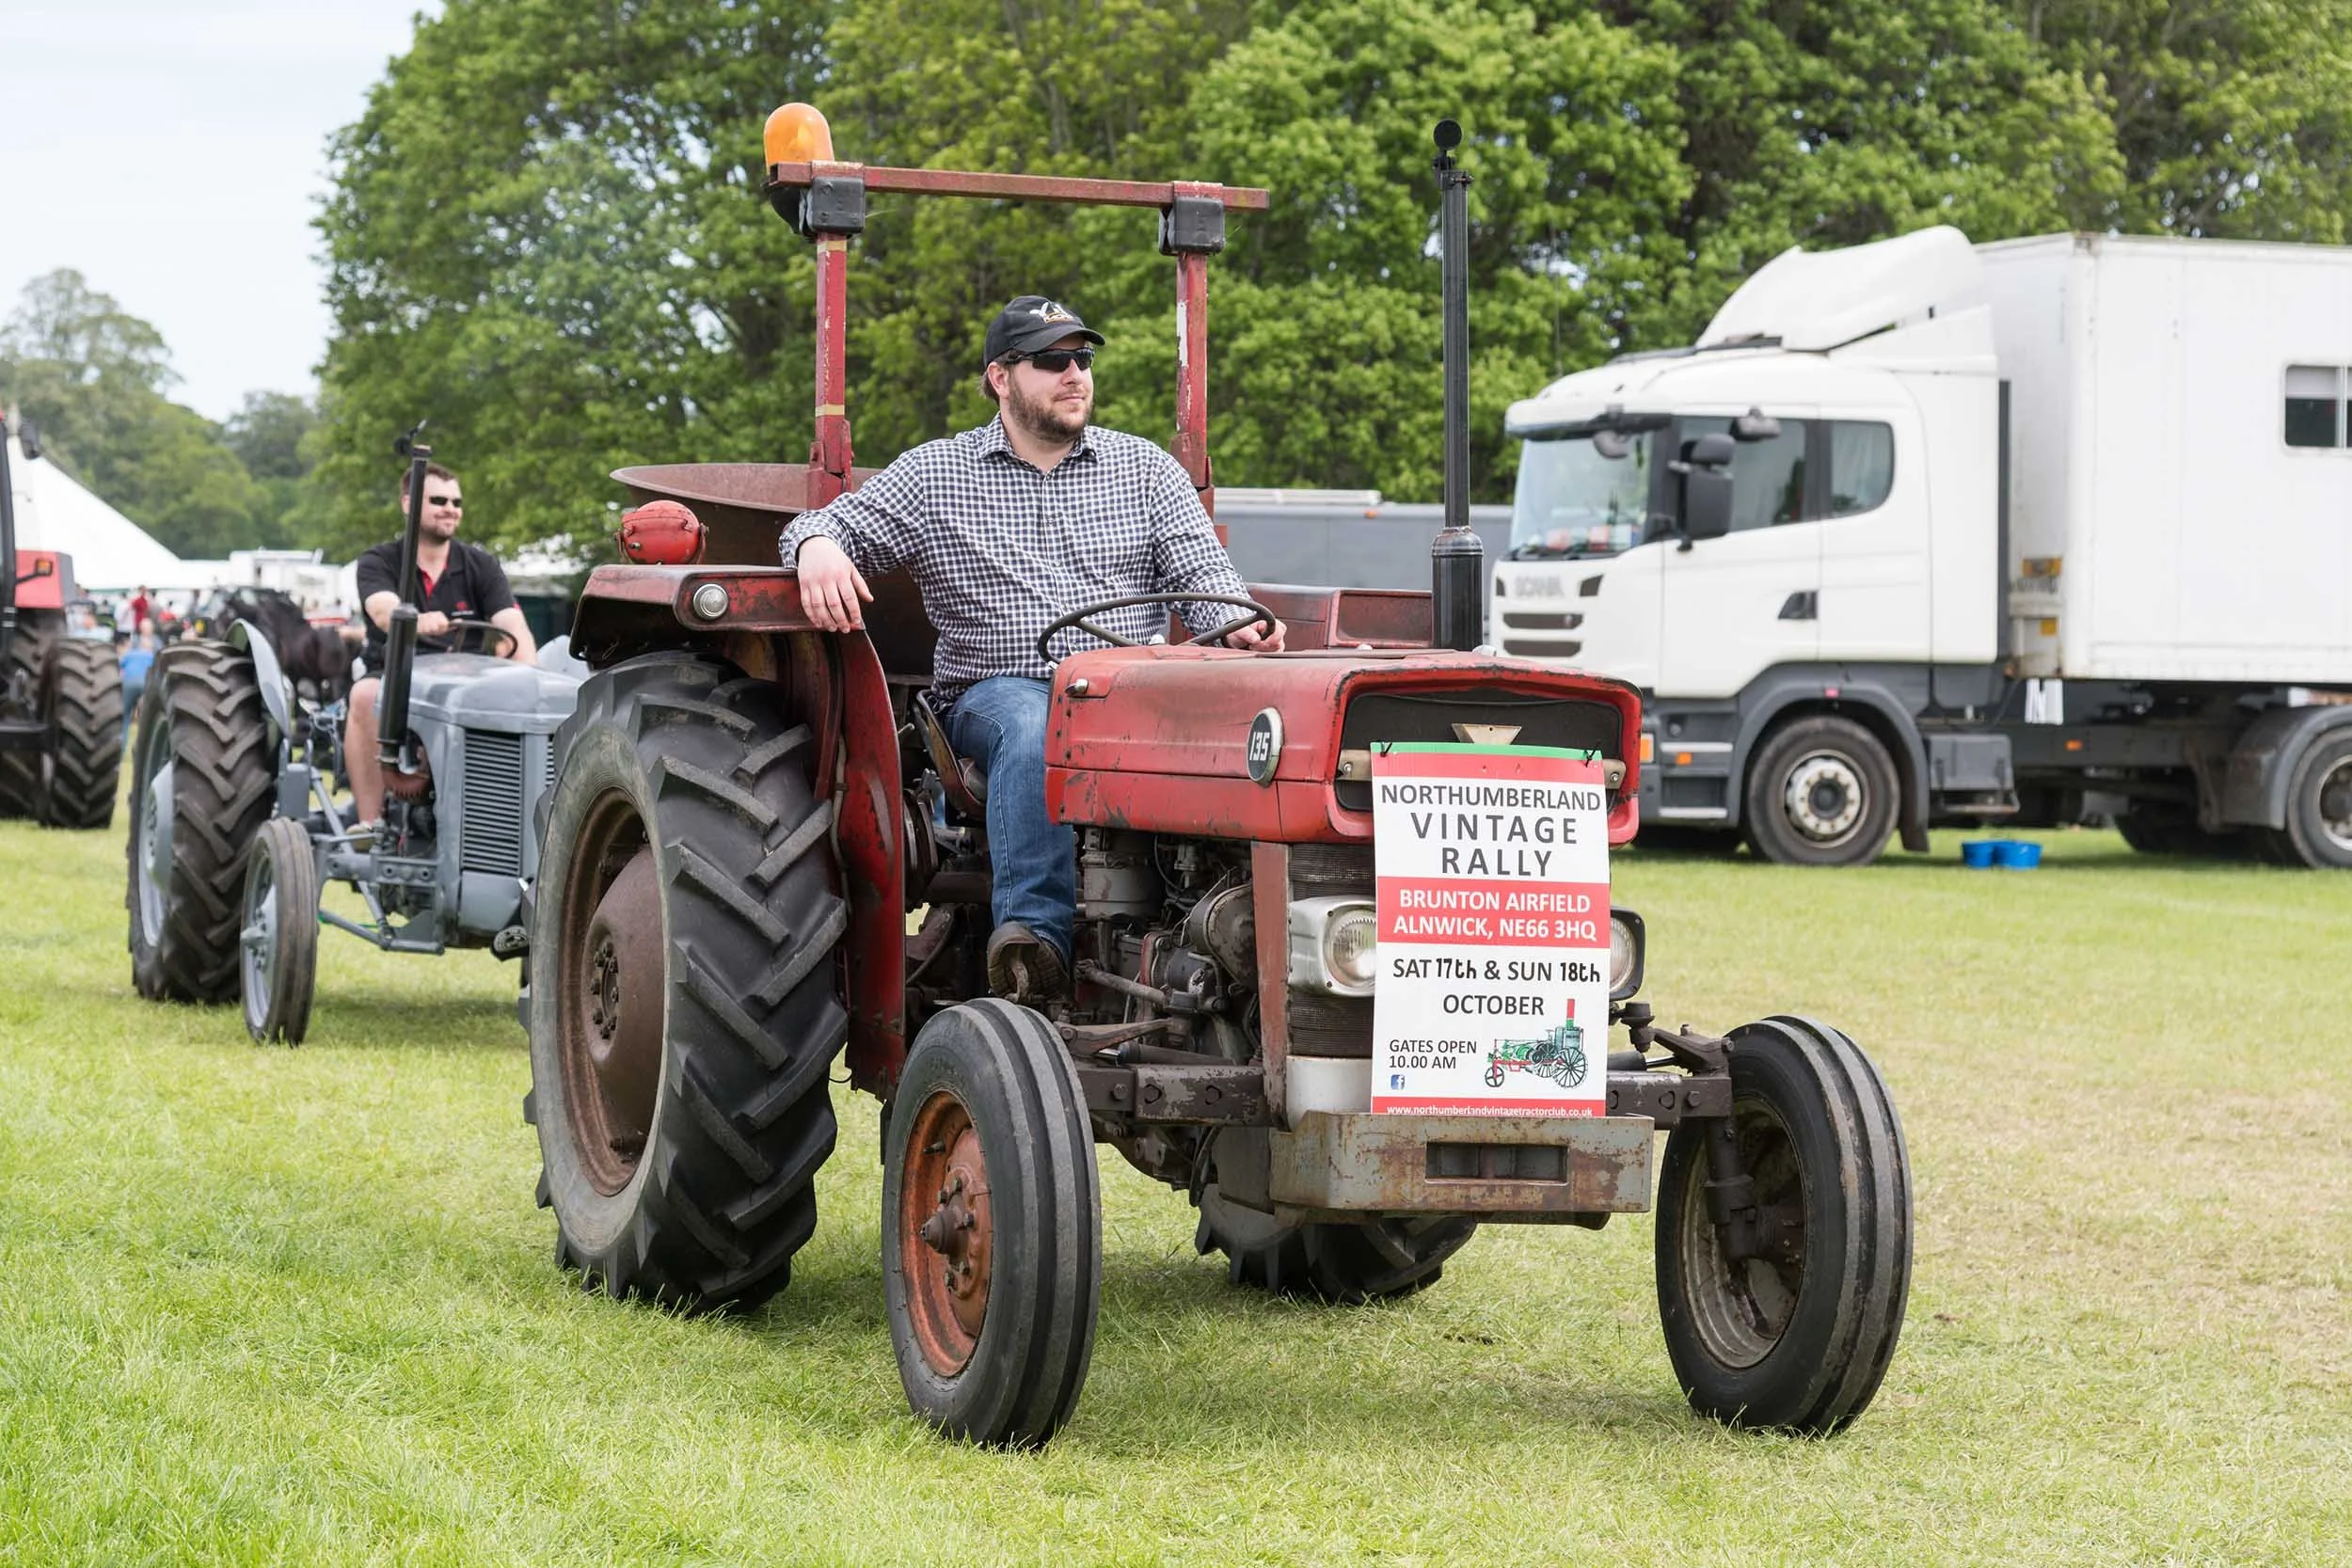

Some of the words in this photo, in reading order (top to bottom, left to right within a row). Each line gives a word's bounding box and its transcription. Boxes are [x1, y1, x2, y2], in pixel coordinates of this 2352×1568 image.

[1249, 732, 1270, 761] 135
[1381, 784, 1601, 811] NORTHUMBERLAND
[1411, 812, 1578, 845] VINTAGE
[1442, 847, 1552, 877] RALLY
[1399, 889, 1500, 911] BRUNTON
[1505, 893, 1591, 913] AIRFIELD
[1393, 915, 1494, 940] ALNWICK,
[1499, 919, 1549, 939] NE66
[1554, 920, 1597, 942] 3HQ
[1392, 958, 1432, 978] SAT
[1436, 958, 1477, 980] 17th
[1484, 960, 1502, 981] &
[1507, 961, 1551, 982] SUN
[1560, 962, 1600, 983] 18th
[1443, 994, 1545, 1016] OCTOBER
[1389, 1039, 1434, 1053] GATES
[1438, 1040, 1477, 1054] OPEN
[1389, 1055, 1430, 1069] 10.00
[1431, 1056, 1456, 1069] AM
[1387, 1104, 1593, 1117] www.northumberlandvintagetractorclub.co.uk
